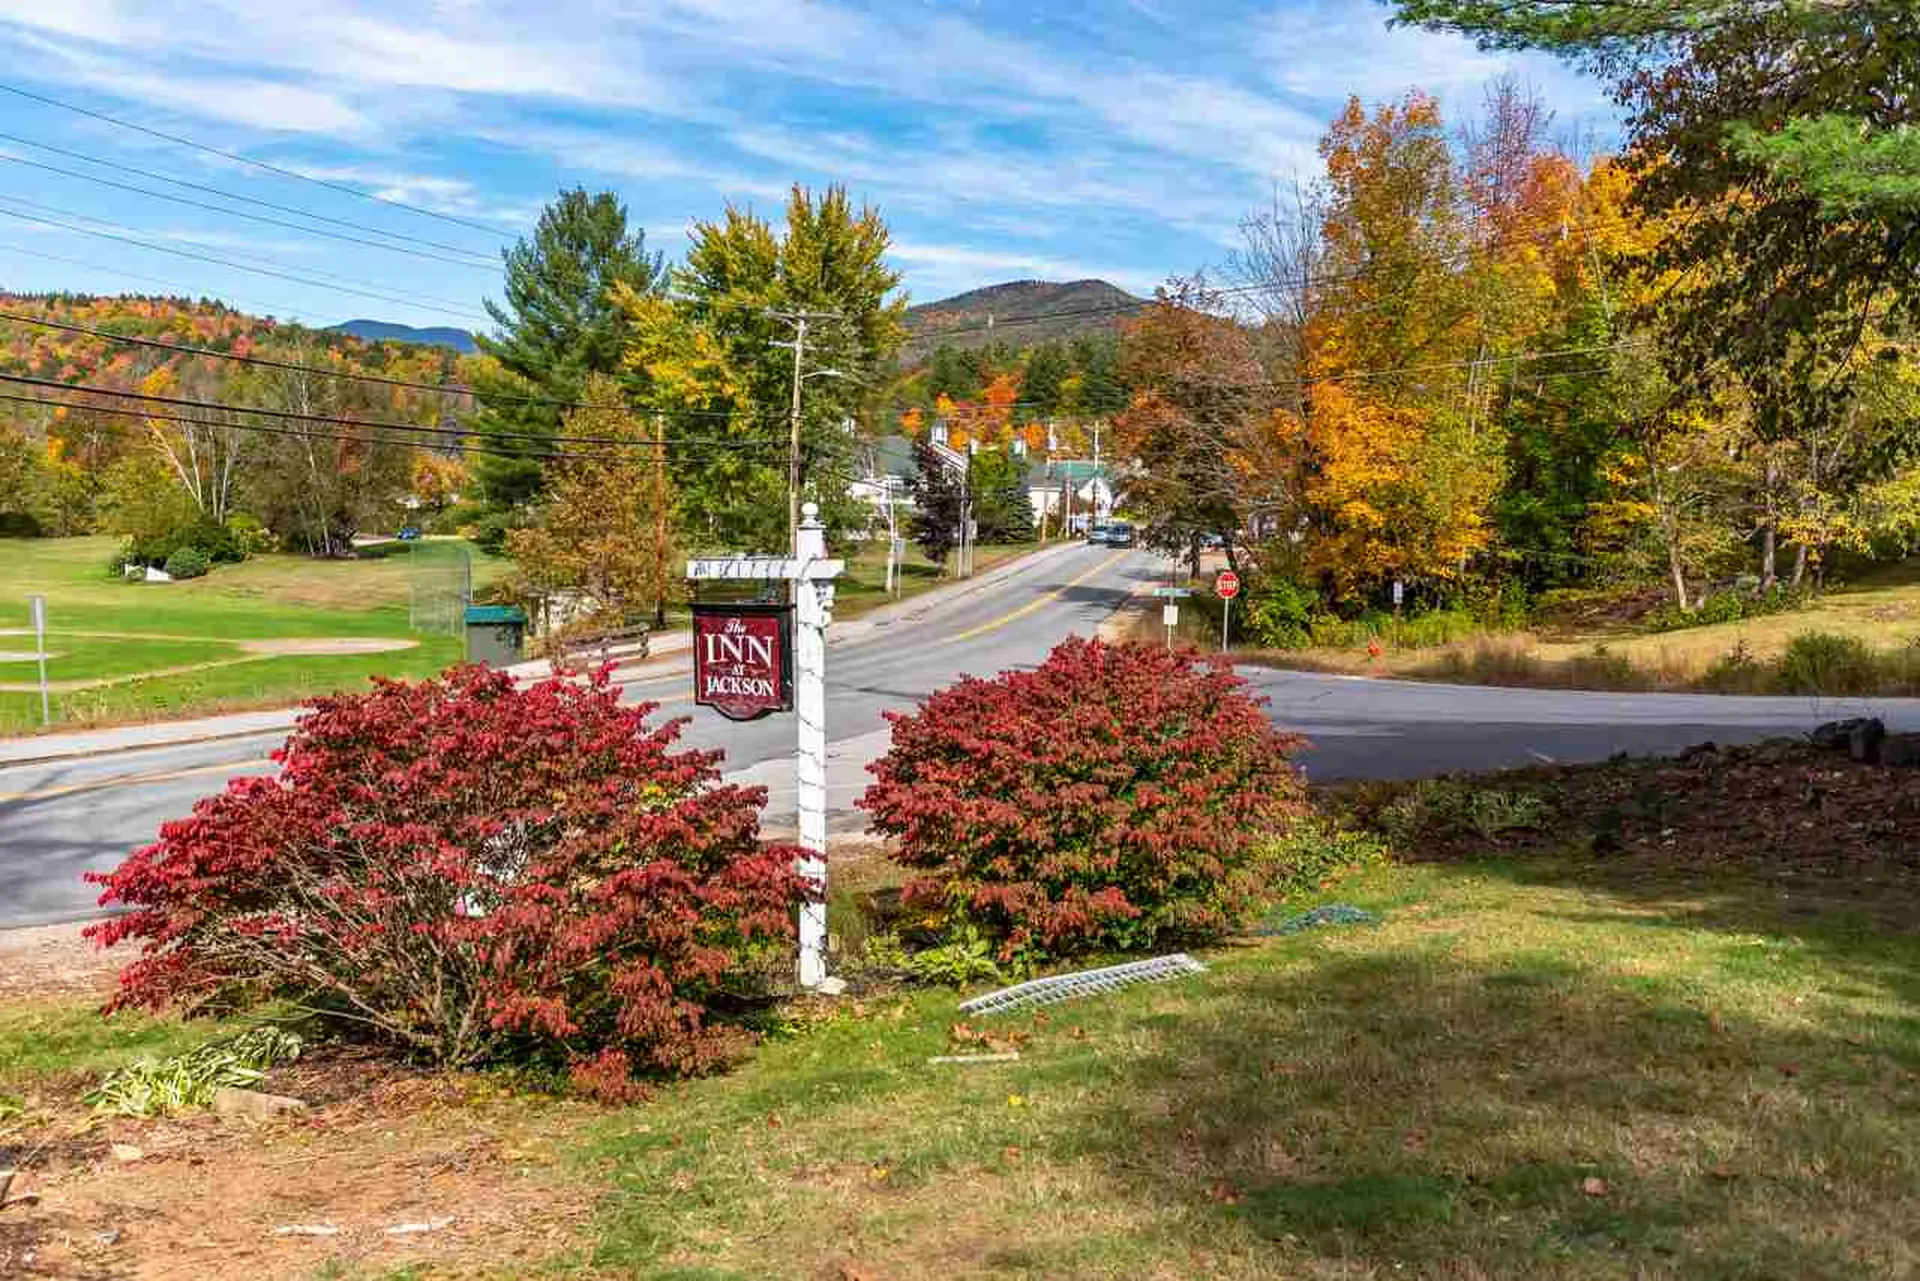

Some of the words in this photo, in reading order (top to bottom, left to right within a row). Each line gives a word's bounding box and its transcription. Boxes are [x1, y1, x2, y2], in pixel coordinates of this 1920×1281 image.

[724, 617, 746, 633] The
[705, 633, 774, 669] INN
[705, 675, 775, 697] JACKSON
